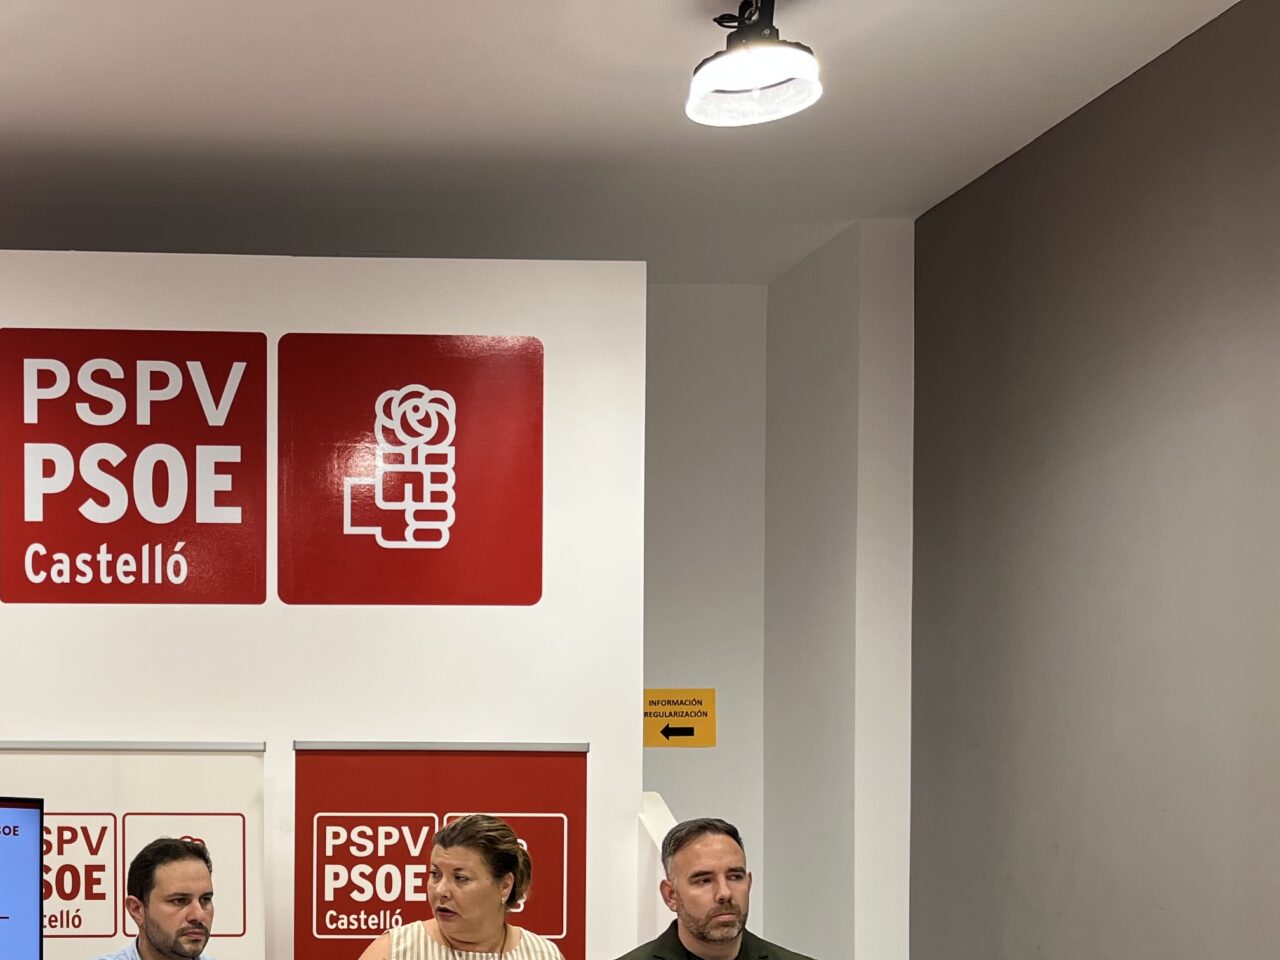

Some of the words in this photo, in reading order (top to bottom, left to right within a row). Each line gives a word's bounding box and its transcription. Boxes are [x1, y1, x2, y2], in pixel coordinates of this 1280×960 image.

[23, 358, 247, 427] PSPV
[23, 442, 242, 524] PSOE
[24, 541, 188, 585] Castelló
[643, 709, 708, 718] REGULARIZACIÓN
[648, 697, 703, 707] INFORMACIÓN
[43, 826, 108, 856] PV
[325, 825, 429, 857] PSPV
[43, 864, 106, 901] OE
[324, 863, 427, 902] PSOE
[325, 908, 402, 930] Castelló
